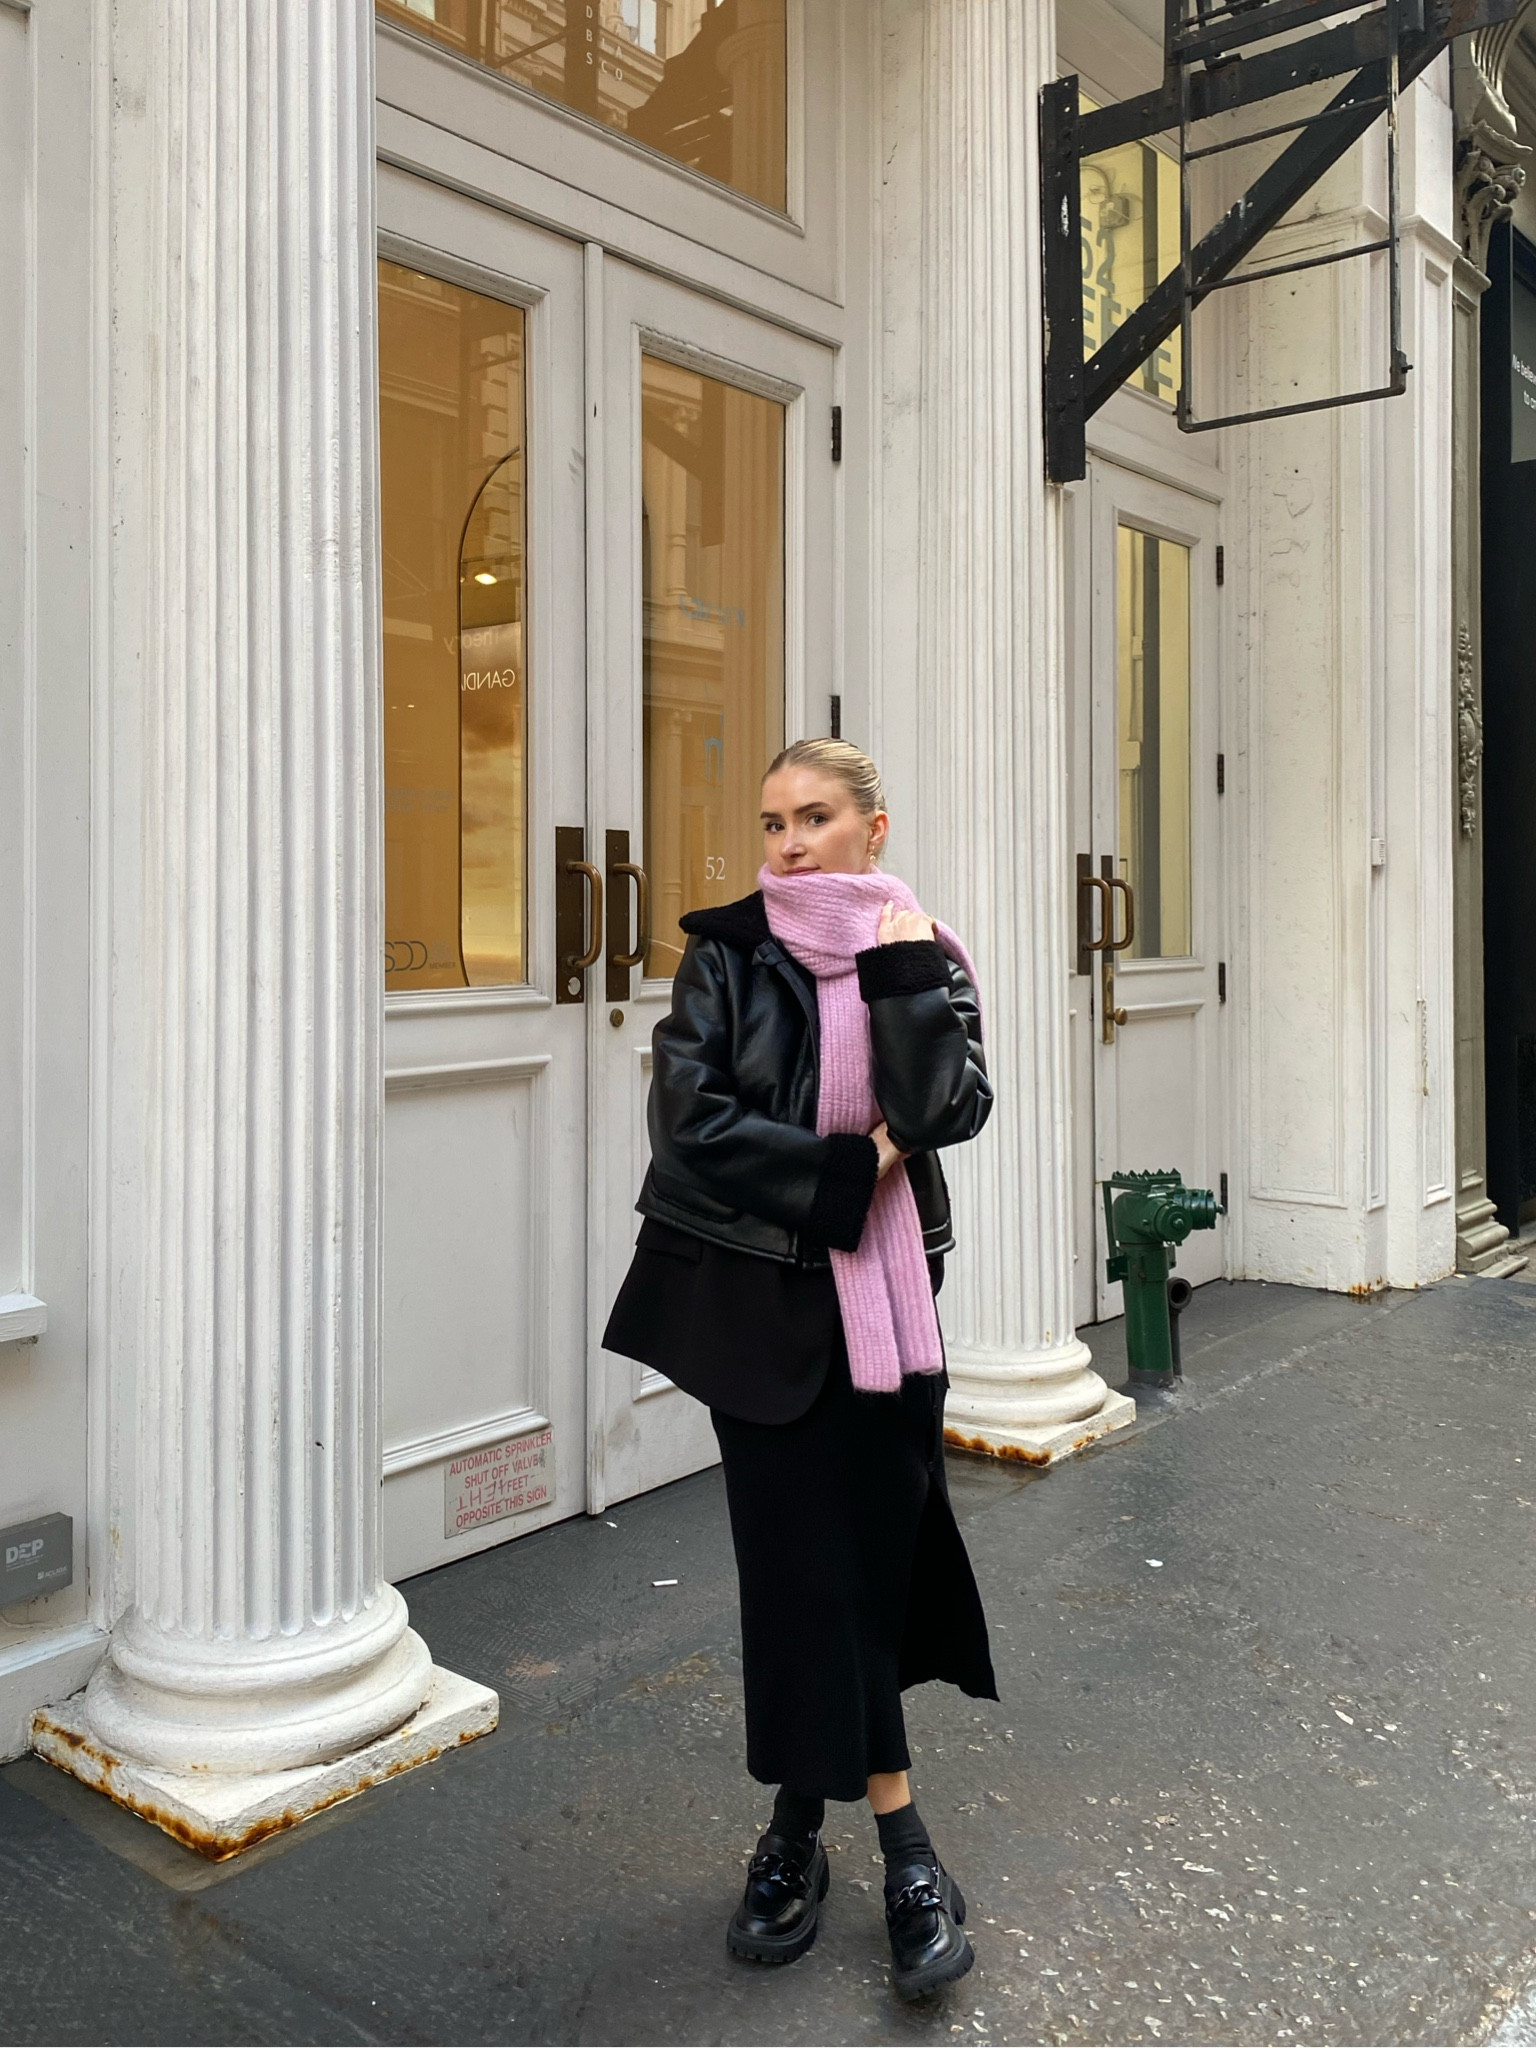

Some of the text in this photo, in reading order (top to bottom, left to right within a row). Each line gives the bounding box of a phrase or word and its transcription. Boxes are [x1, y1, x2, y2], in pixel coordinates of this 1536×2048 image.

[705, 856, 726, 880] 52
[450, 1431, 552, 1476] AUTOMATIC SPRINKLER
[464, 1454, 539, 1489] SHUT OFF VALVE
[507, 1474, 529, 1493] FEET
[456, 1502, 502, 1528] OPPOSITE
[505, 1494, 524, 1511] THIS
[527, 1486, 547, 1504] SIGN
[6, 1539, 44, 1564] DEP
